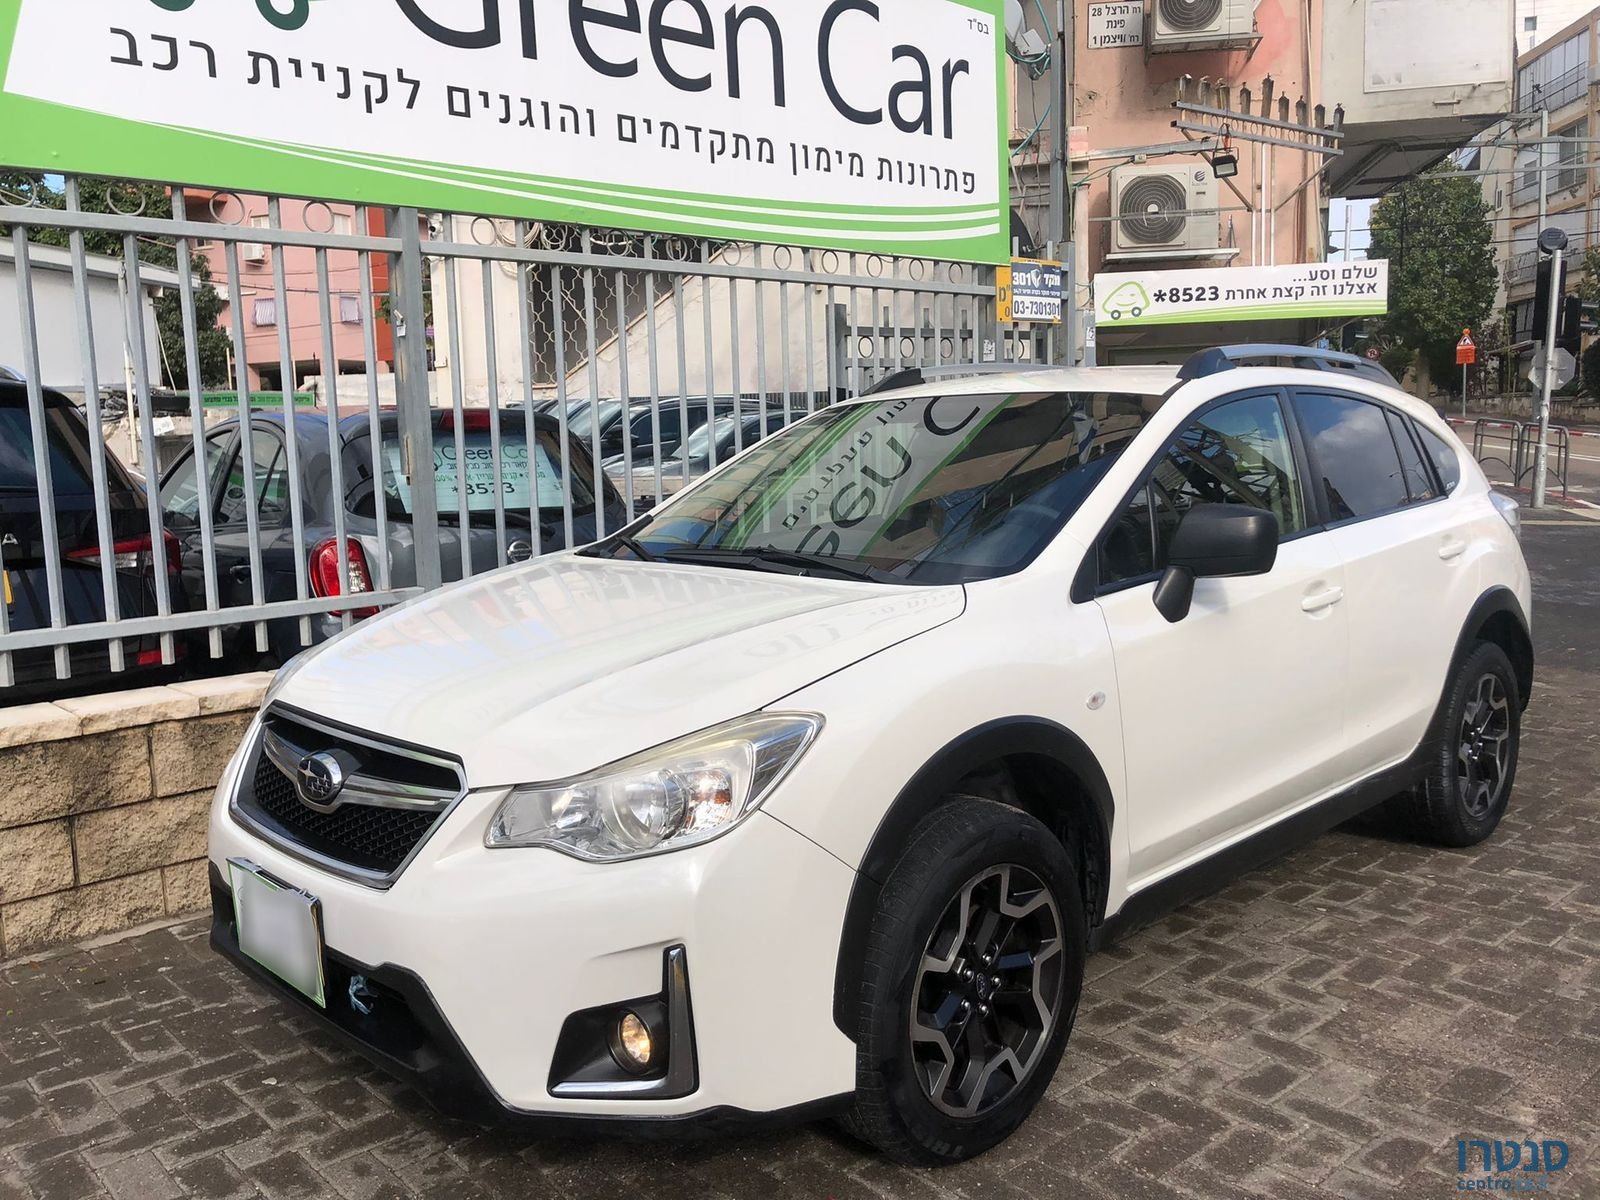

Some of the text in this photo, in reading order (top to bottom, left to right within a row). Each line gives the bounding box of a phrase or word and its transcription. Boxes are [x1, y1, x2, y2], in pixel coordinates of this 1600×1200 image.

[1091, 7, 1103, 17] 28
[1105, 4, 1129, 16] הרצל
[967, 18, 989, 35] בס"ד
[1105, 19, 1126, 29] פינת
[1092, 35, 1098, 45] 1
[1100, 33, 1126, 47] וויצמן
[817, 0, 969, 140] Car
[110, 27, 976, 195] פתרונות מימון מתקדמים והוגנים לקניית רכב
[1012, 271, 1032, 286] 301
[1293, 265, 1378, 282] שלם וסע...
[1224, 287, 1268, 301] אחרת
[1271, 285, 1305, 301] קצת
[1310, 285, 1328, 297] זה
[1333, 281, 1378, 296] אצלנו
[1013, 300, 1061, 317] 03-7301301
